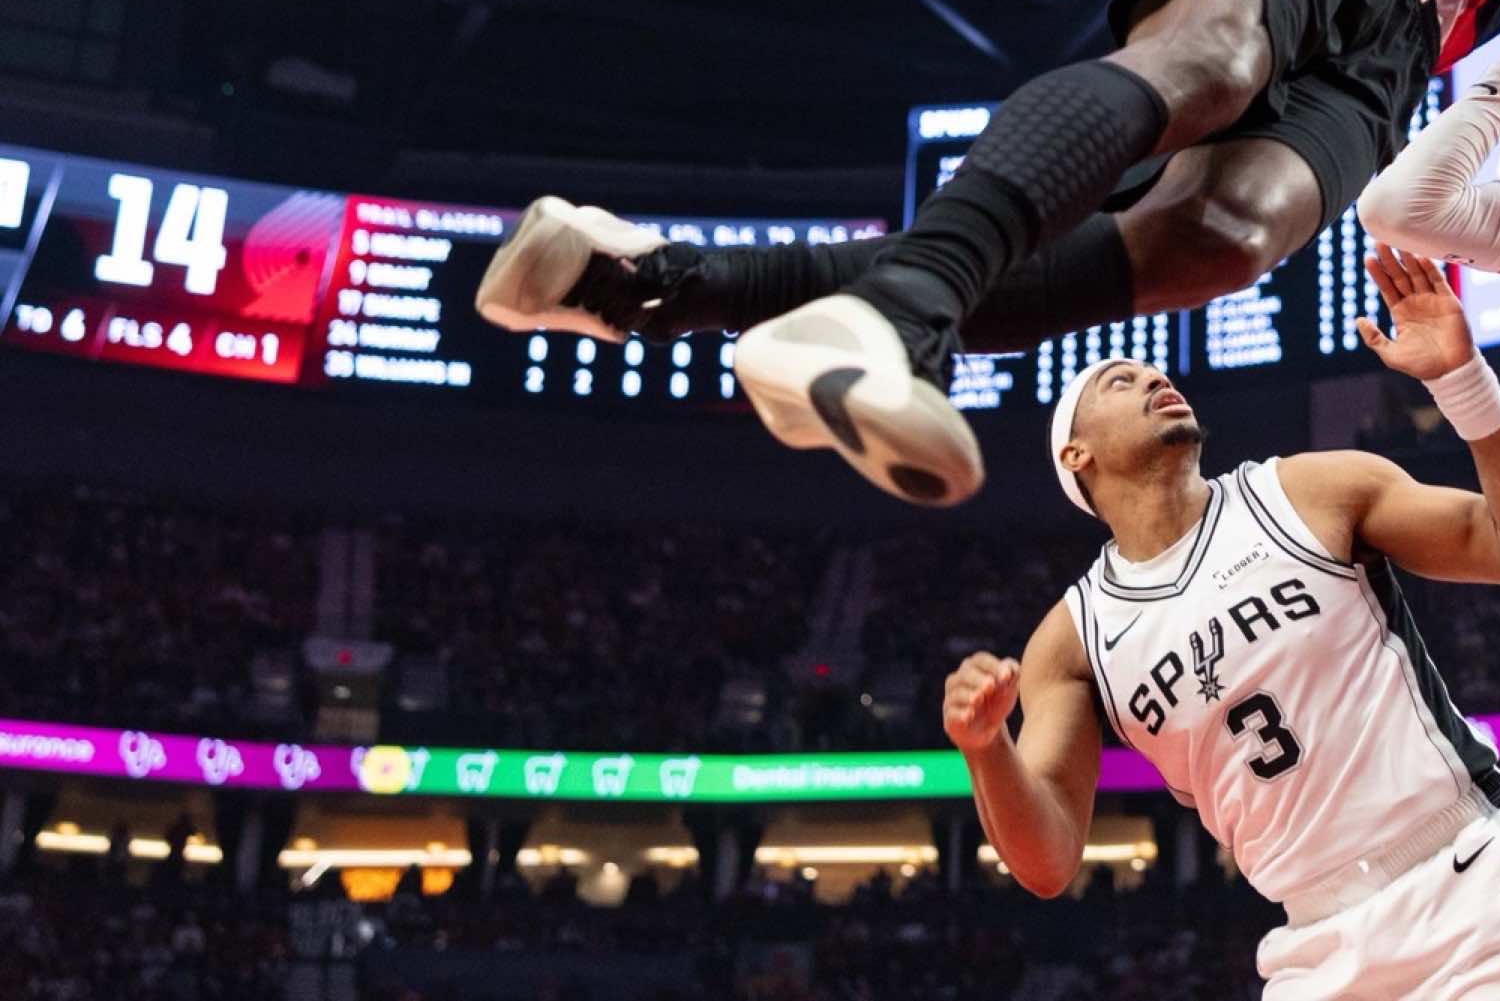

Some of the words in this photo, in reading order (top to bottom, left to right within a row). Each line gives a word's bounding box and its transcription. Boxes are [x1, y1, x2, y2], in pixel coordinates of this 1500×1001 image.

[94, 173, 229, 296] 14
[1220, 550, 1261, 580] LEDGER
[1128, 578, 1321, 736] SPURS
[812, 761, 925, 789] insurance
[1223, 687, 1305, 783] 3
